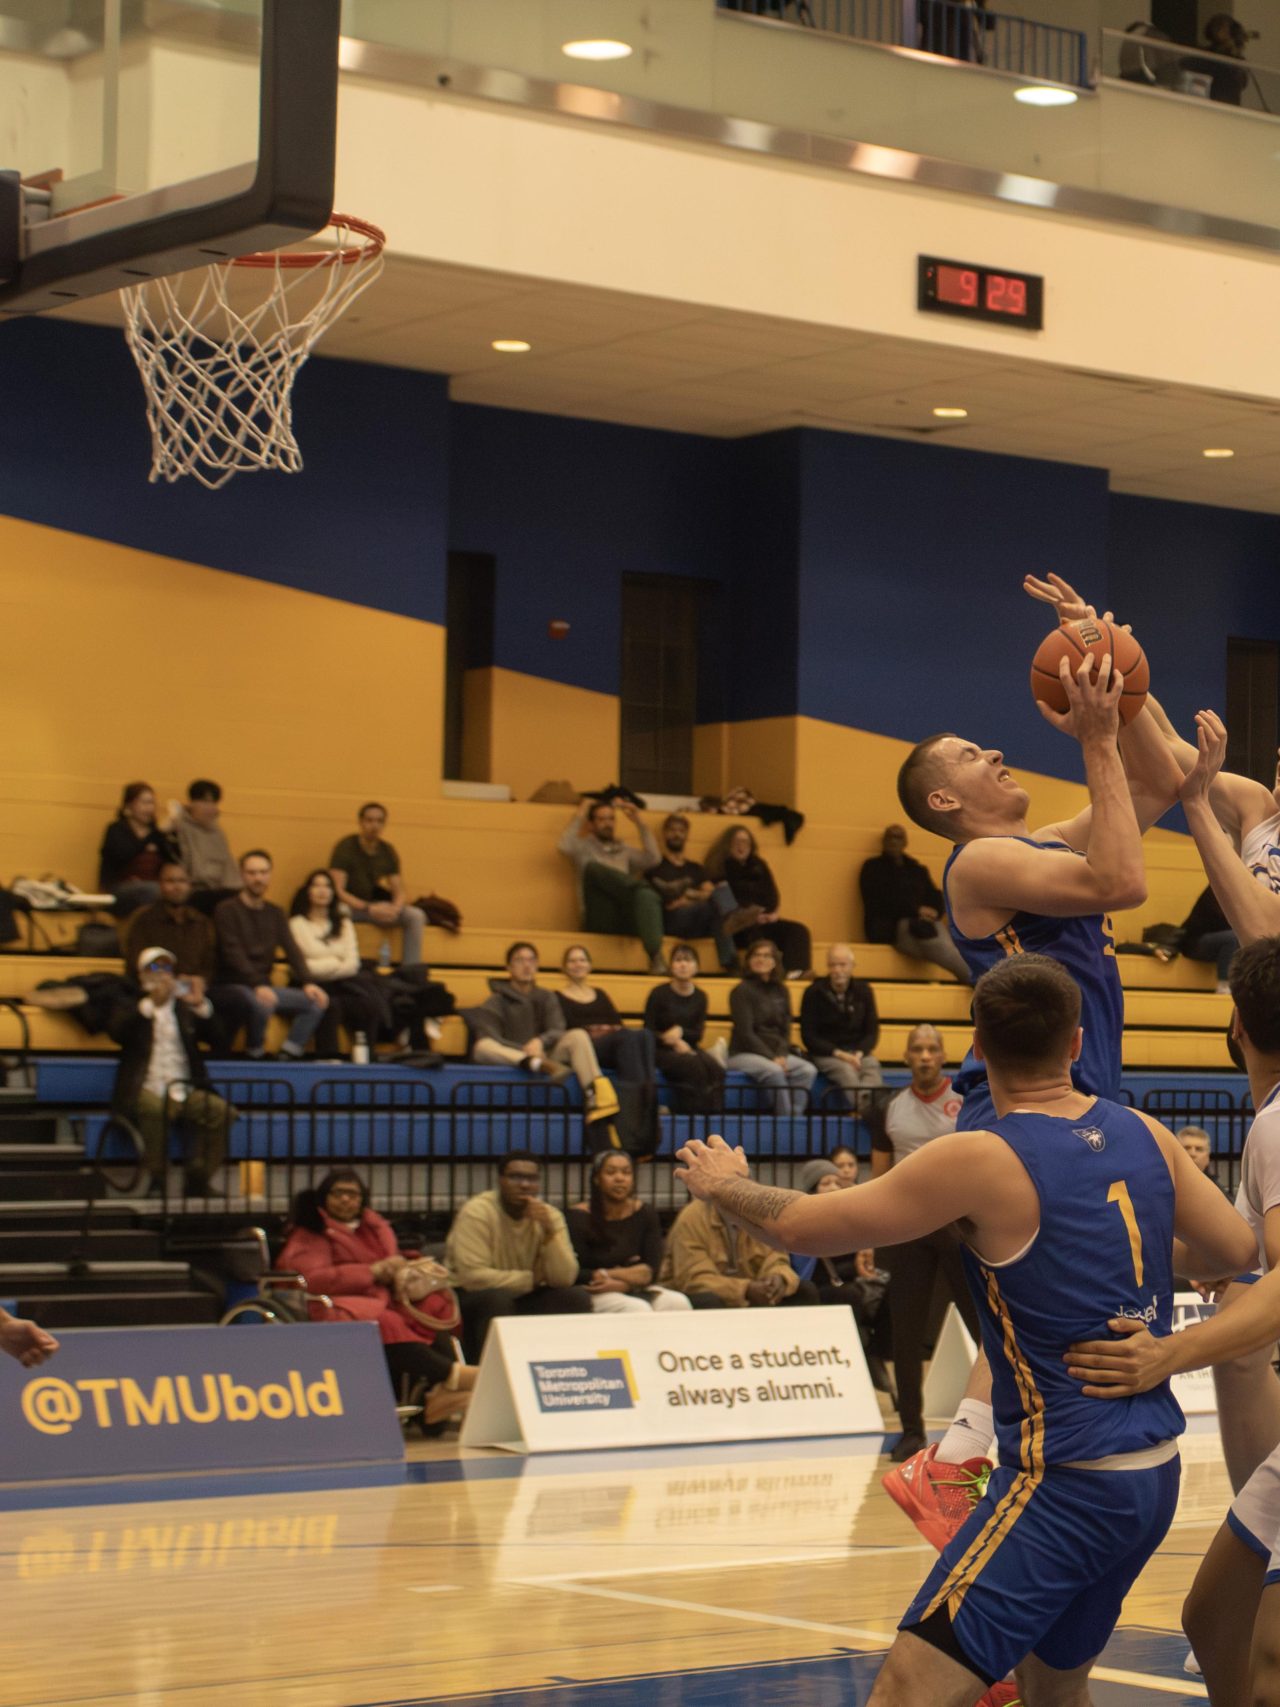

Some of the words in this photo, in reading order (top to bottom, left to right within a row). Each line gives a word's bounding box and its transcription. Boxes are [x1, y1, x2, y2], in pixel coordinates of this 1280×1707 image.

[960, 269, 978, 306] 9
[985, 275, 1026, 315] 29
[1106, 1179, 1145, 1289] 1
[657, 1350, 724, 1373] Once
[730, 1353, 744, 1370] a
[750, 1345, 852, 1368] student,
[21, 1368, 345, 1435] @TMUbold
[667, 1384, 750, 1409] always
[756, 1376, 844, 1402] alumni.
